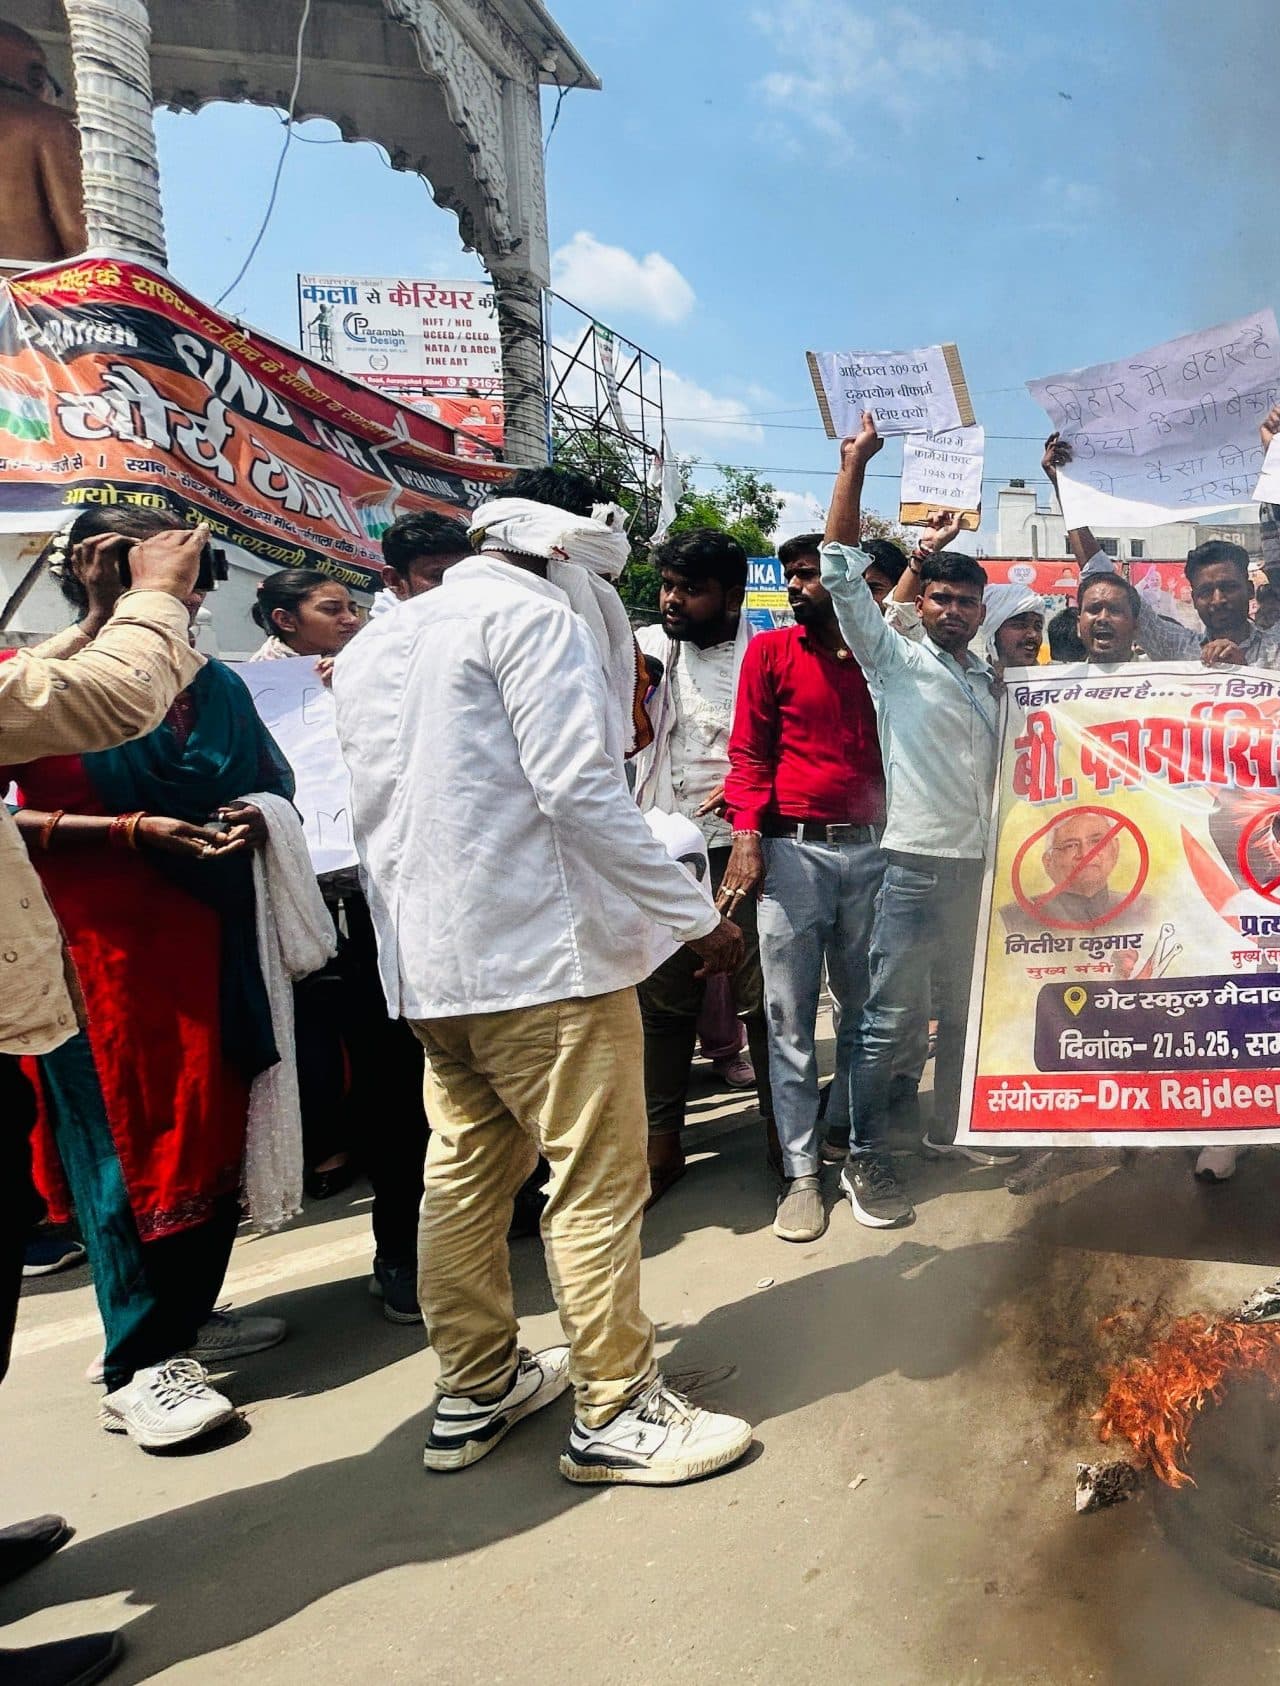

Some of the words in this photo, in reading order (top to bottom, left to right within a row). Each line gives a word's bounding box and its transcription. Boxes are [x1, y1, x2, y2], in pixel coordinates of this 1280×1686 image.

[95, 263, 121, 286] के
[302, 284, 358, 305] कला
[365, 288, 381, 304] से
[387, 280, 476, 310] कैरियर
[354, 317, 405, 337] Prarambh
[422, 317, 444, 327] NIFT
[370, 336, 406, 346] Design
[423, 331, 455, 340] UCEED
[466, 333, 490, 341] CEED
[424, 343, 451, 353] NATA
[425, 356, 447, 366] FINE
[449, 358, 469, 366] ART
[840, 363, 886, 378] आर्टिकल
[889, 364, 909, 376] 309
[911, 362, 928, 373] का
[874, 407, 899, 421] लिए
[71, 453, 84, 470] से
[126, 457, 166, 476] स्थान
[923, 468, 946, 479] 1948
[948, 471, 964, 480] का
[919, 485, 947, 495] पालन
[1014, 686, 1060, 710] बिहार
[1084, 685, 1134, 699] बहार
[1226, 678, 1273, 699] डिग्री
[1013, 710, 1073, 802] बी.
[1004, 931, 1074, 955] नितीश
[1080, 933, 1144, 959] कुमार
[1231, 950, 1261, 968] मुख्य
[1026, 966, 1068, 979] मुख्य
[1075, 961, 1114, 974] मंत्री
[1094, 988, 1136, 1010] गेट
[1139, 988, 1212, 1017] स्कुल
[1153, 1030, 1239, 1060] 27.5.25,
